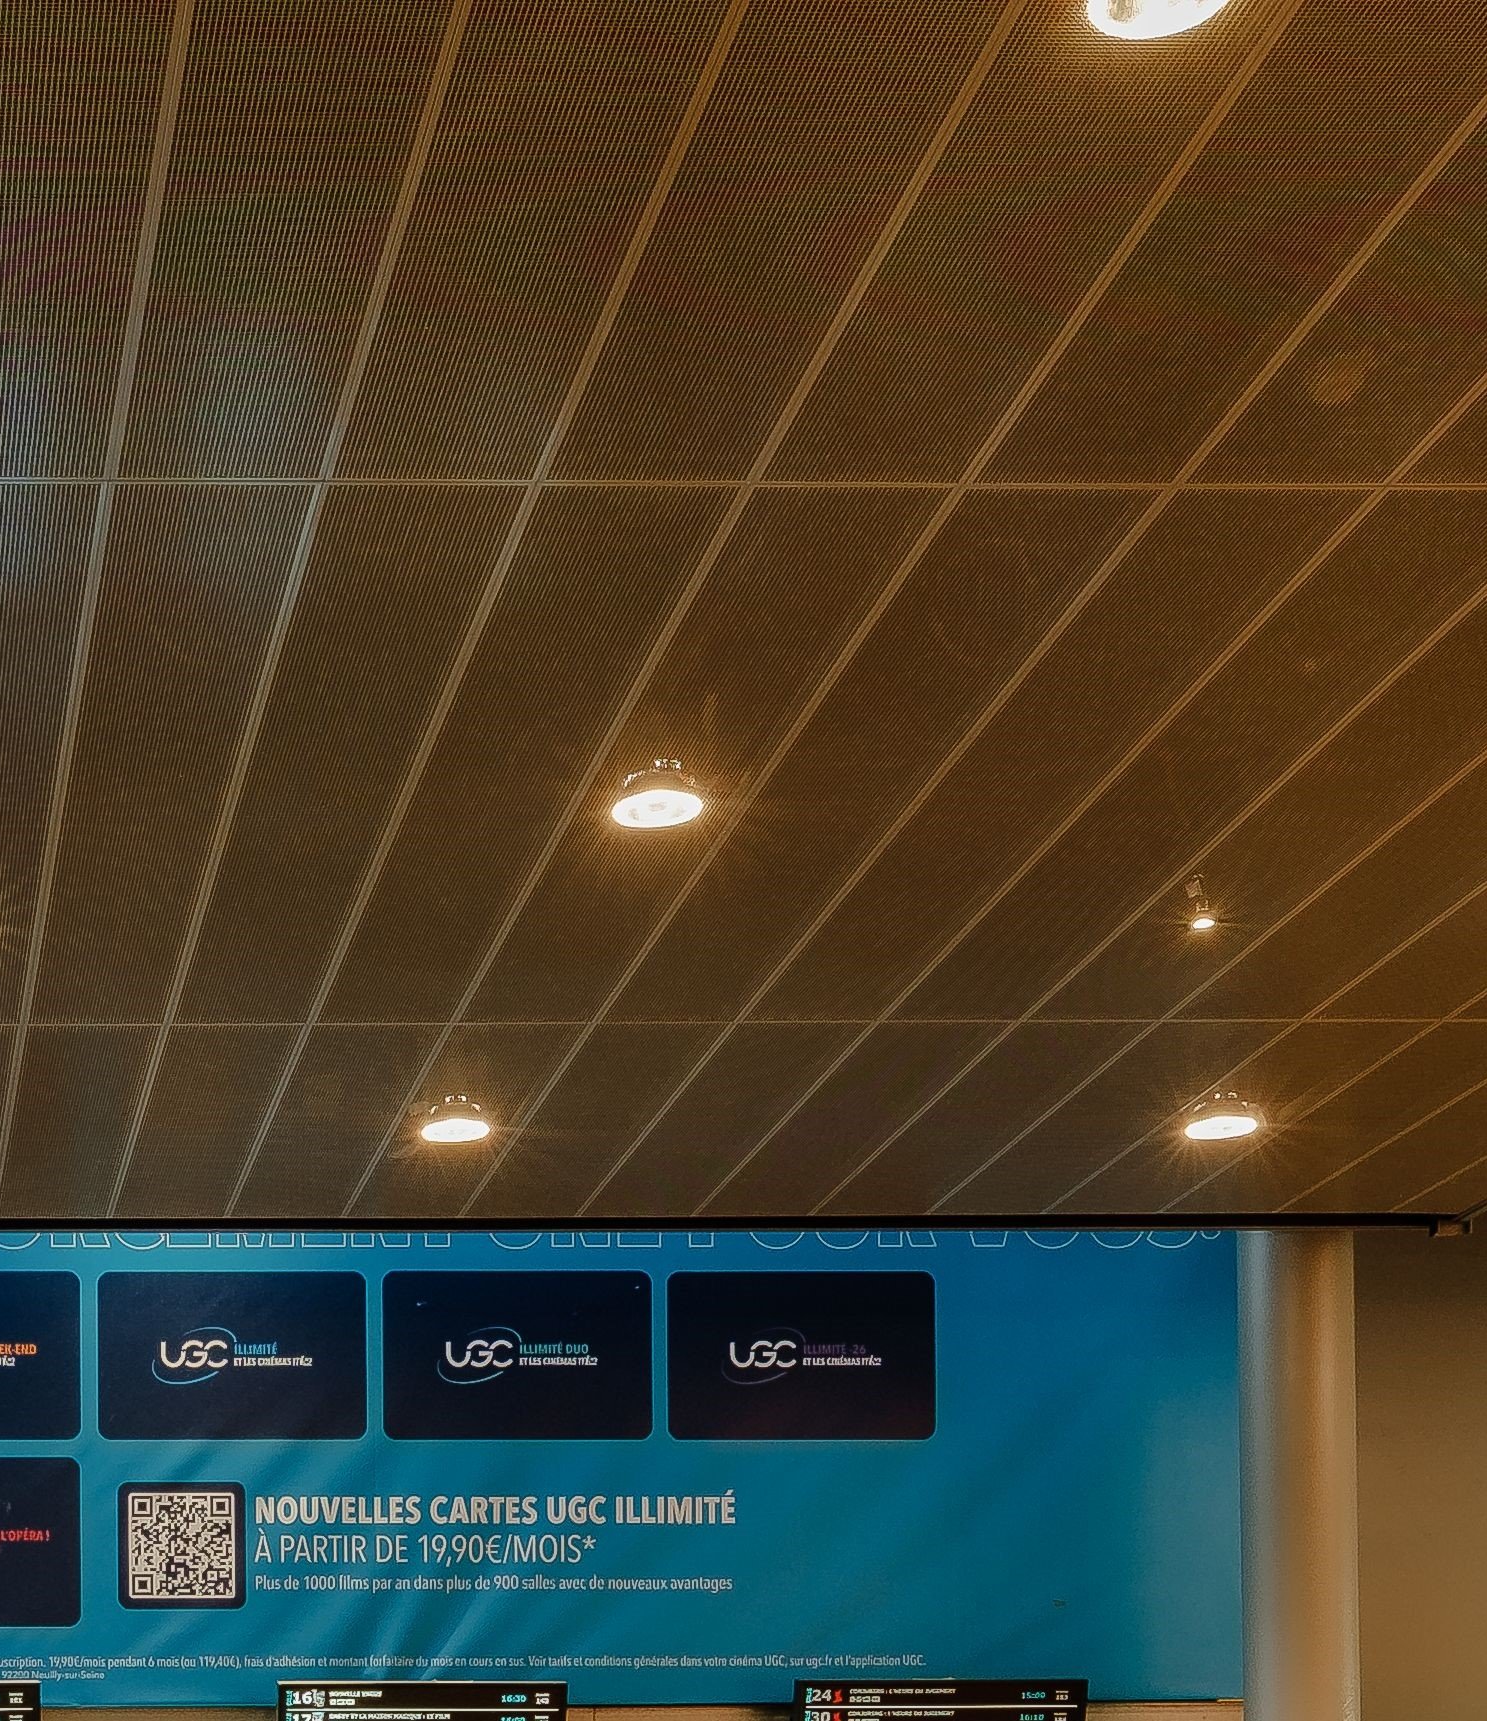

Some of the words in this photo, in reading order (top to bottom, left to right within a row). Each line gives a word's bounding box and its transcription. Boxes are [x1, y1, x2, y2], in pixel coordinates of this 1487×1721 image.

[160, 1339, 228, 1368] UGC
[234, 1341, 277, 1355] ILLIMITÉ
[445, 1339, 513, 1368] UGC
[519, 1341, 562, 1354] ILLIMITÉ
[565, 1343, 589, 1354] DUO
[729, 1340, 796, 1368] UGC
[803, 1342, 846, 1354] ILLIMITÉ
[255, 1495, 421, 1524] NOUVELLES
[430, 1495, 537, 1524] CARTES
[546, 1495, 606, 1524] UGC
[615, 1489, 736, 1524] ILLIMITÉ
[254, 1527, 272, 1563] À
[280, 1535, 367, 1563] PARTIR
[376, 1535, 408, 1563] DE
[255, 1575, 281, 1590] Plus
[284, 1575, 299, 1590] de
[304, 1575, 335, 1590] 1000
[339, 1575, 369, 1590] films
[373, 1578, 391, 1593] par
[395, 1578, 411, 1590] an
[414, 1575, 443, 1590] dans
[447, 1575, 471, 1593] plus
[475, 1575, 490, 1590] de
[492, 1575, 518, 1590] 900
[521, 1575, 555, 1590] salles
[559, 1578, 584, 1590] avec
[589, 1575, 604, 1590] de
[608, 1578, 667, 1590] nouveaux
[670, 1577, 732, 1593] avantages
[293, 1692, 312, 1705] 16
[812, 1689, 832, 1702] 24
